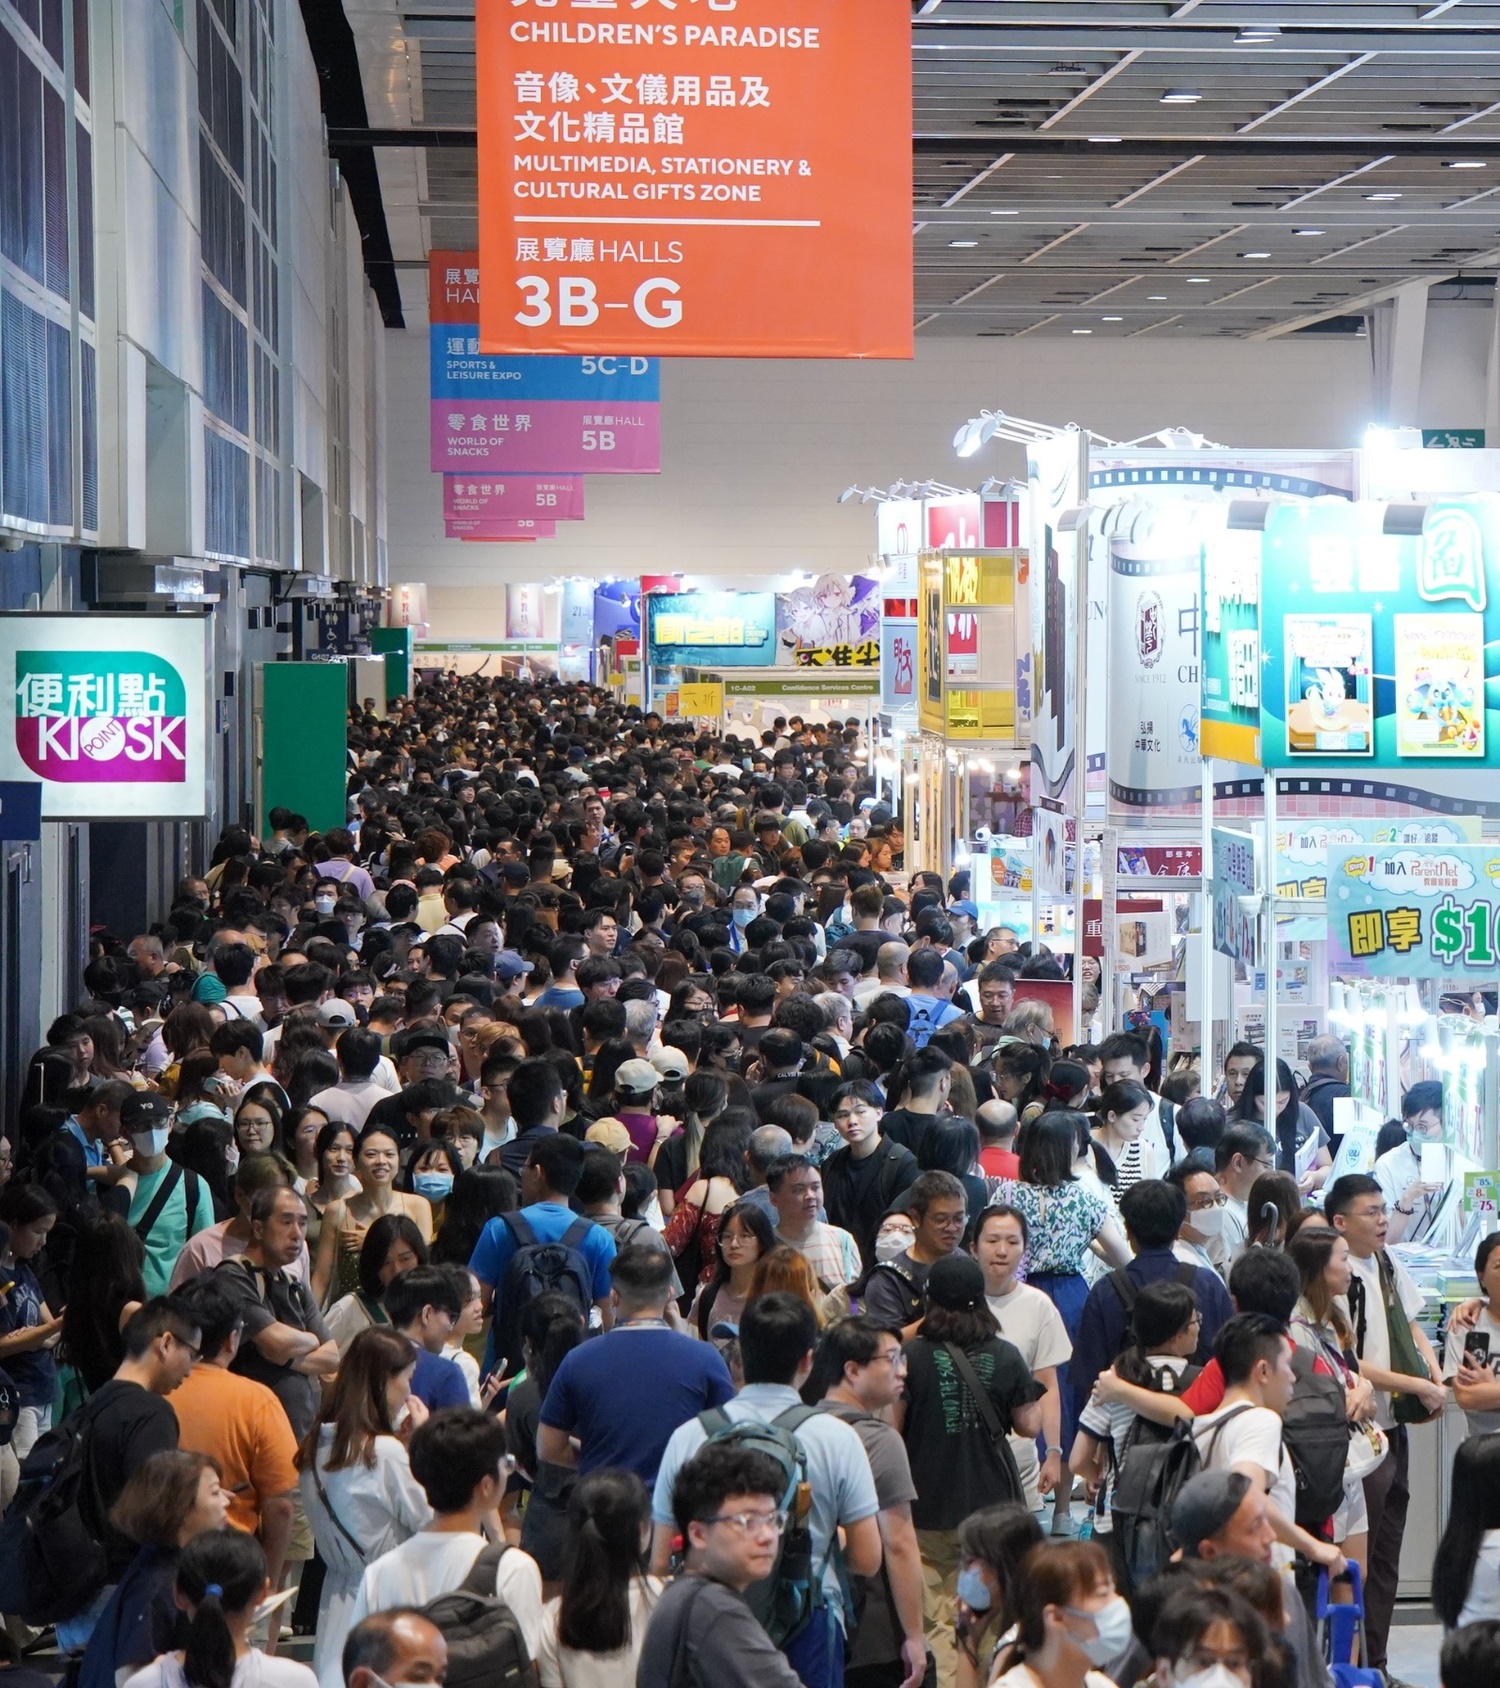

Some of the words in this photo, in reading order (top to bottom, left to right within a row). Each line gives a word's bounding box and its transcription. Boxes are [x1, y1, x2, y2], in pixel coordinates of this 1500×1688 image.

[685, 26, 820, 48] PARADISE
[514, 71, 770, 107] 音像、文儀用品及
[514, 111, 685, 144] 文化精品館
[513, 155, 656, 175] MULTIMEDIA,
[661, 157, 792, 176] STATIONERY
[797, 159, 812, 176] &
[513, 181, 628, 200] CULTURAL
[633, 182, 695, 200] GIFTS
[700, 184, 761, 202] ZONE
[600, 240, 683, 263] HALLS
[446, 360, 487, 370] SPORTS
[489, 361, 496, 370] &
[447, 371, 490, 380] LEISURE
[492, 371, 522, 380] EXPO
[447, 414, 532, 431] 零食世界
[447, 437, 486, 446] WORLD
[489, 437, 504, 446] OF
[582, 431, 615, 450] 5B
[447, 447, 489, 456] SNACKS
[453, 484, 505, 496] 零食世界
[536, 494, 557, 506] 5B
[1134, 673, 1151, 684] SINCE
[1152, 673, 1166, 684] 1912
[16, 673, 166, 718] 便利點
[782, 684, 820, 692] Confidence
[821, 684, 849, 692] Services
[84, 718, 123, 757] POINT
[1134, 738, 1161, 752] 中華文化
[1385, 861, 1406, 875] 加入
[1348, 907, 1423, 957] 即享
